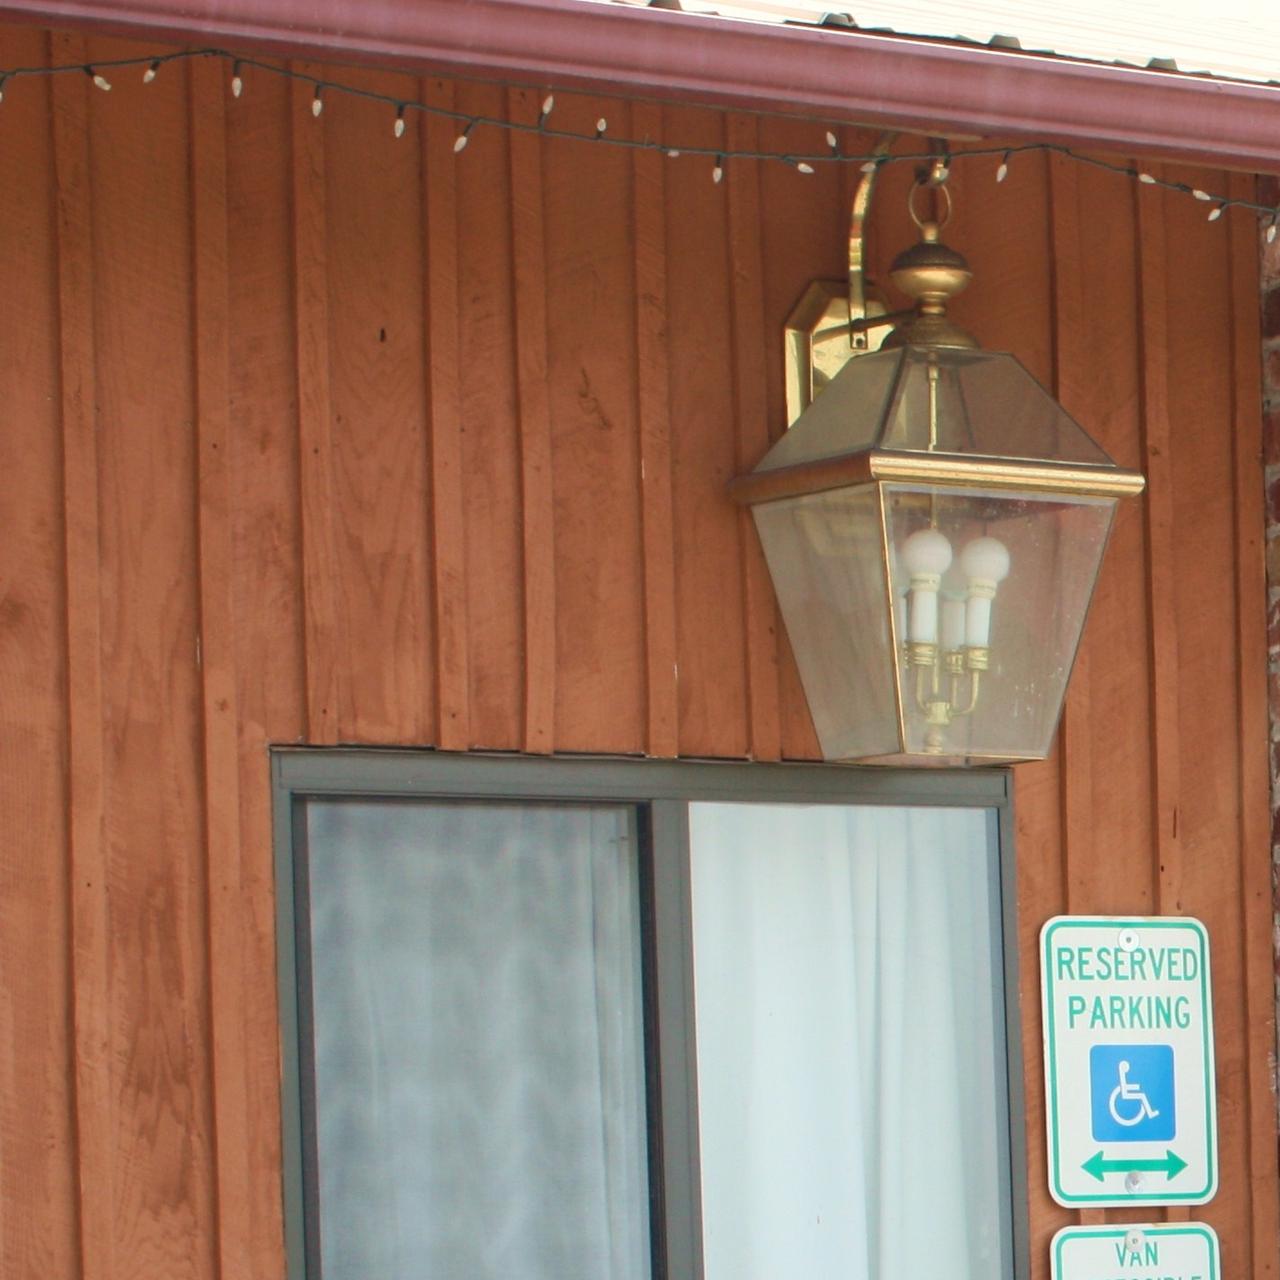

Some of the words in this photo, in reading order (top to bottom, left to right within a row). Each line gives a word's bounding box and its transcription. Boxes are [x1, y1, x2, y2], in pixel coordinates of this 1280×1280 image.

[1056, 946, 1198, 981] RESERVED
[1068, 995, 1191, 1029] PARKING
[1115, 1241, 1158, 1267] VAN
